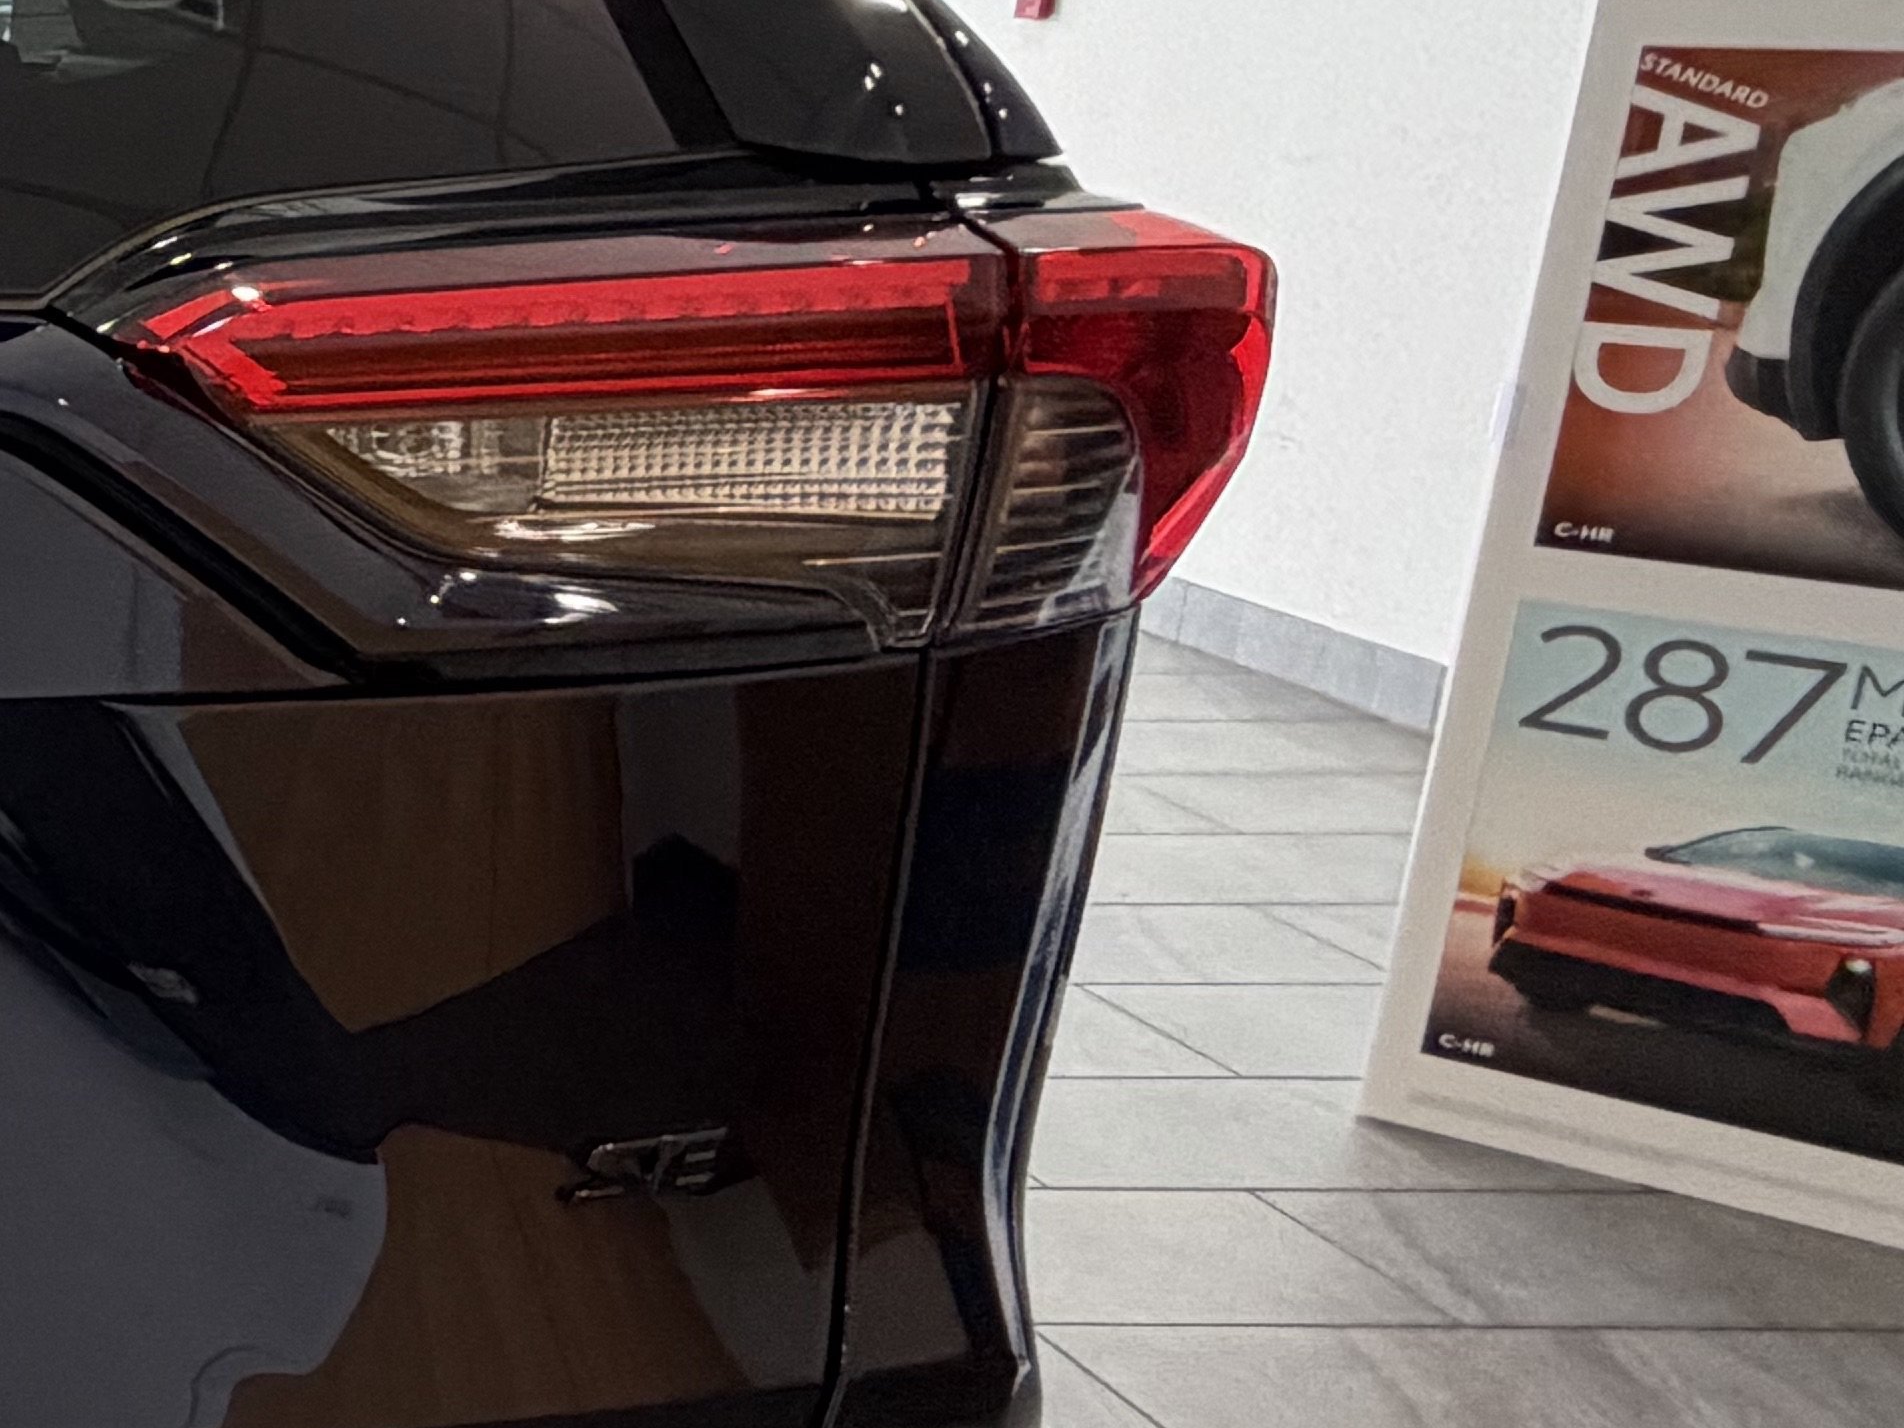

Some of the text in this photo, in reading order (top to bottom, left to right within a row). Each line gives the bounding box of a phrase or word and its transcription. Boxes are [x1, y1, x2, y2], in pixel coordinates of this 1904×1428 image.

[1640, 51, 1770, 110] STANDARD
[1574, 83, 1761, 414] AWD
[1517, 624, 1849, 765] 287
